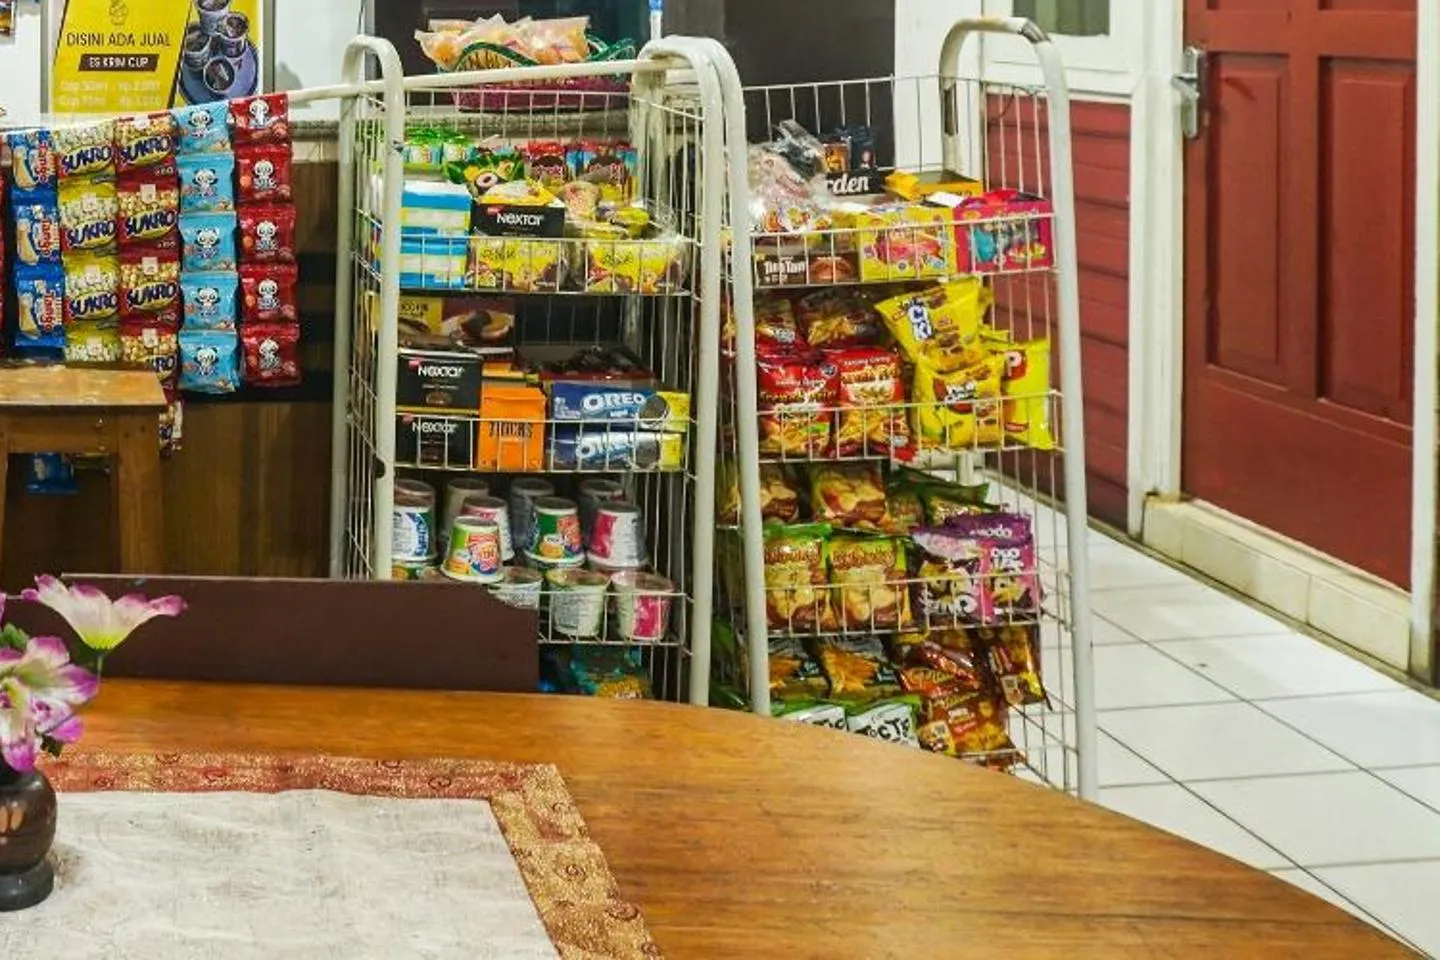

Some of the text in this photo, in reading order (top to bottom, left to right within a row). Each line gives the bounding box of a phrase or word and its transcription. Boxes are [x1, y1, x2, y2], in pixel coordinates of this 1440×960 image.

[66, 32, 171, 47] DISINI ADA JUAL
[128, 57, 149, 68] CUP
[62, 145, 113, 172] SUKRO
[121, 136, 172, 162] SUKRO
[66, 220, 115, 247] SUKRO
[125, 209, 176, 238] SUKRO
[582, 392, 645, 412] OREO
